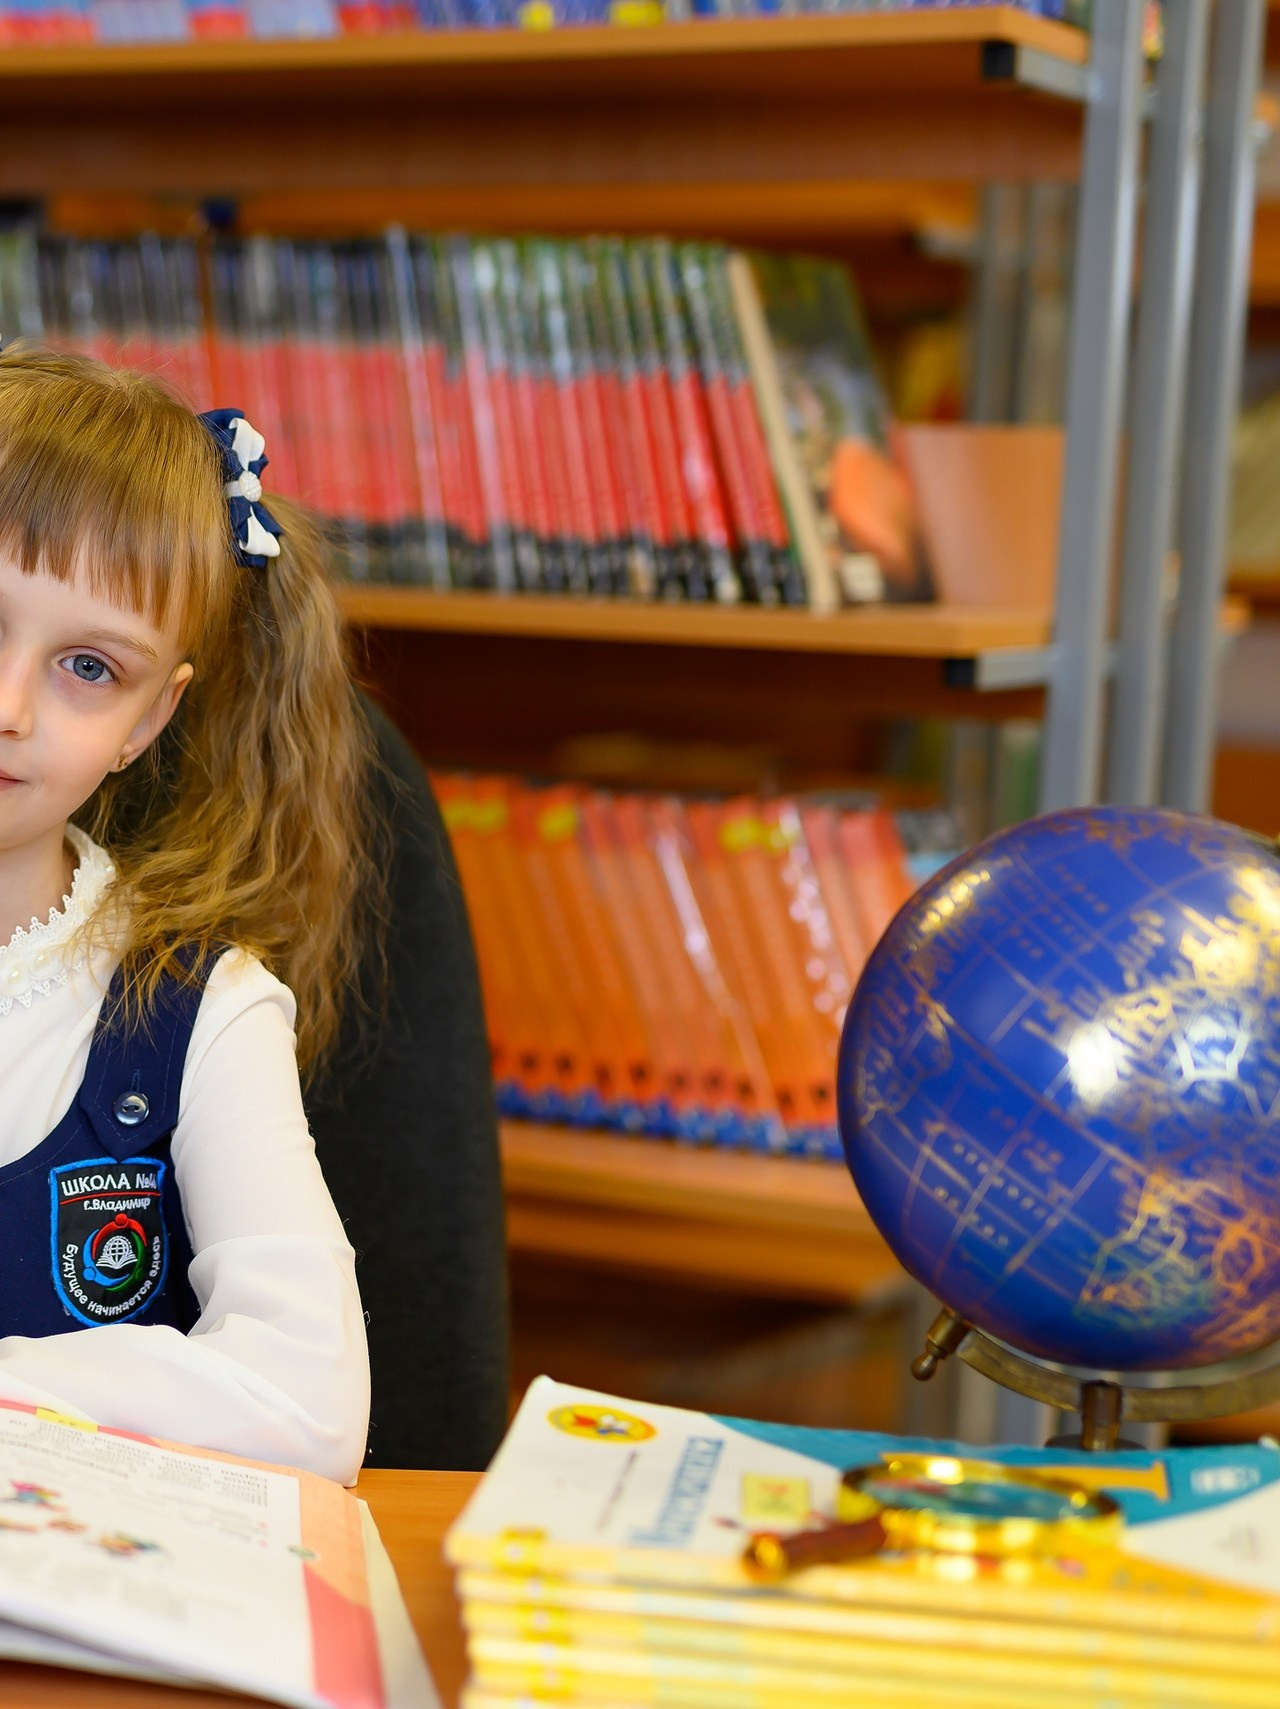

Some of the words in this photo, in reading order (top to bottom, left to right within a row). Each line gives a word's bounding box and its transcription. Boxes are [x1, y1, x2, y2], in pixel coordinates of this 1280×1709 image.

[61, 1173, 131, 1196] ШКОЛА
[83, 1198, 151, 1212] г.Владимир
[62, 1244, 88, 1304] Будущее
[87, 1280, 152, 1316] начинается
